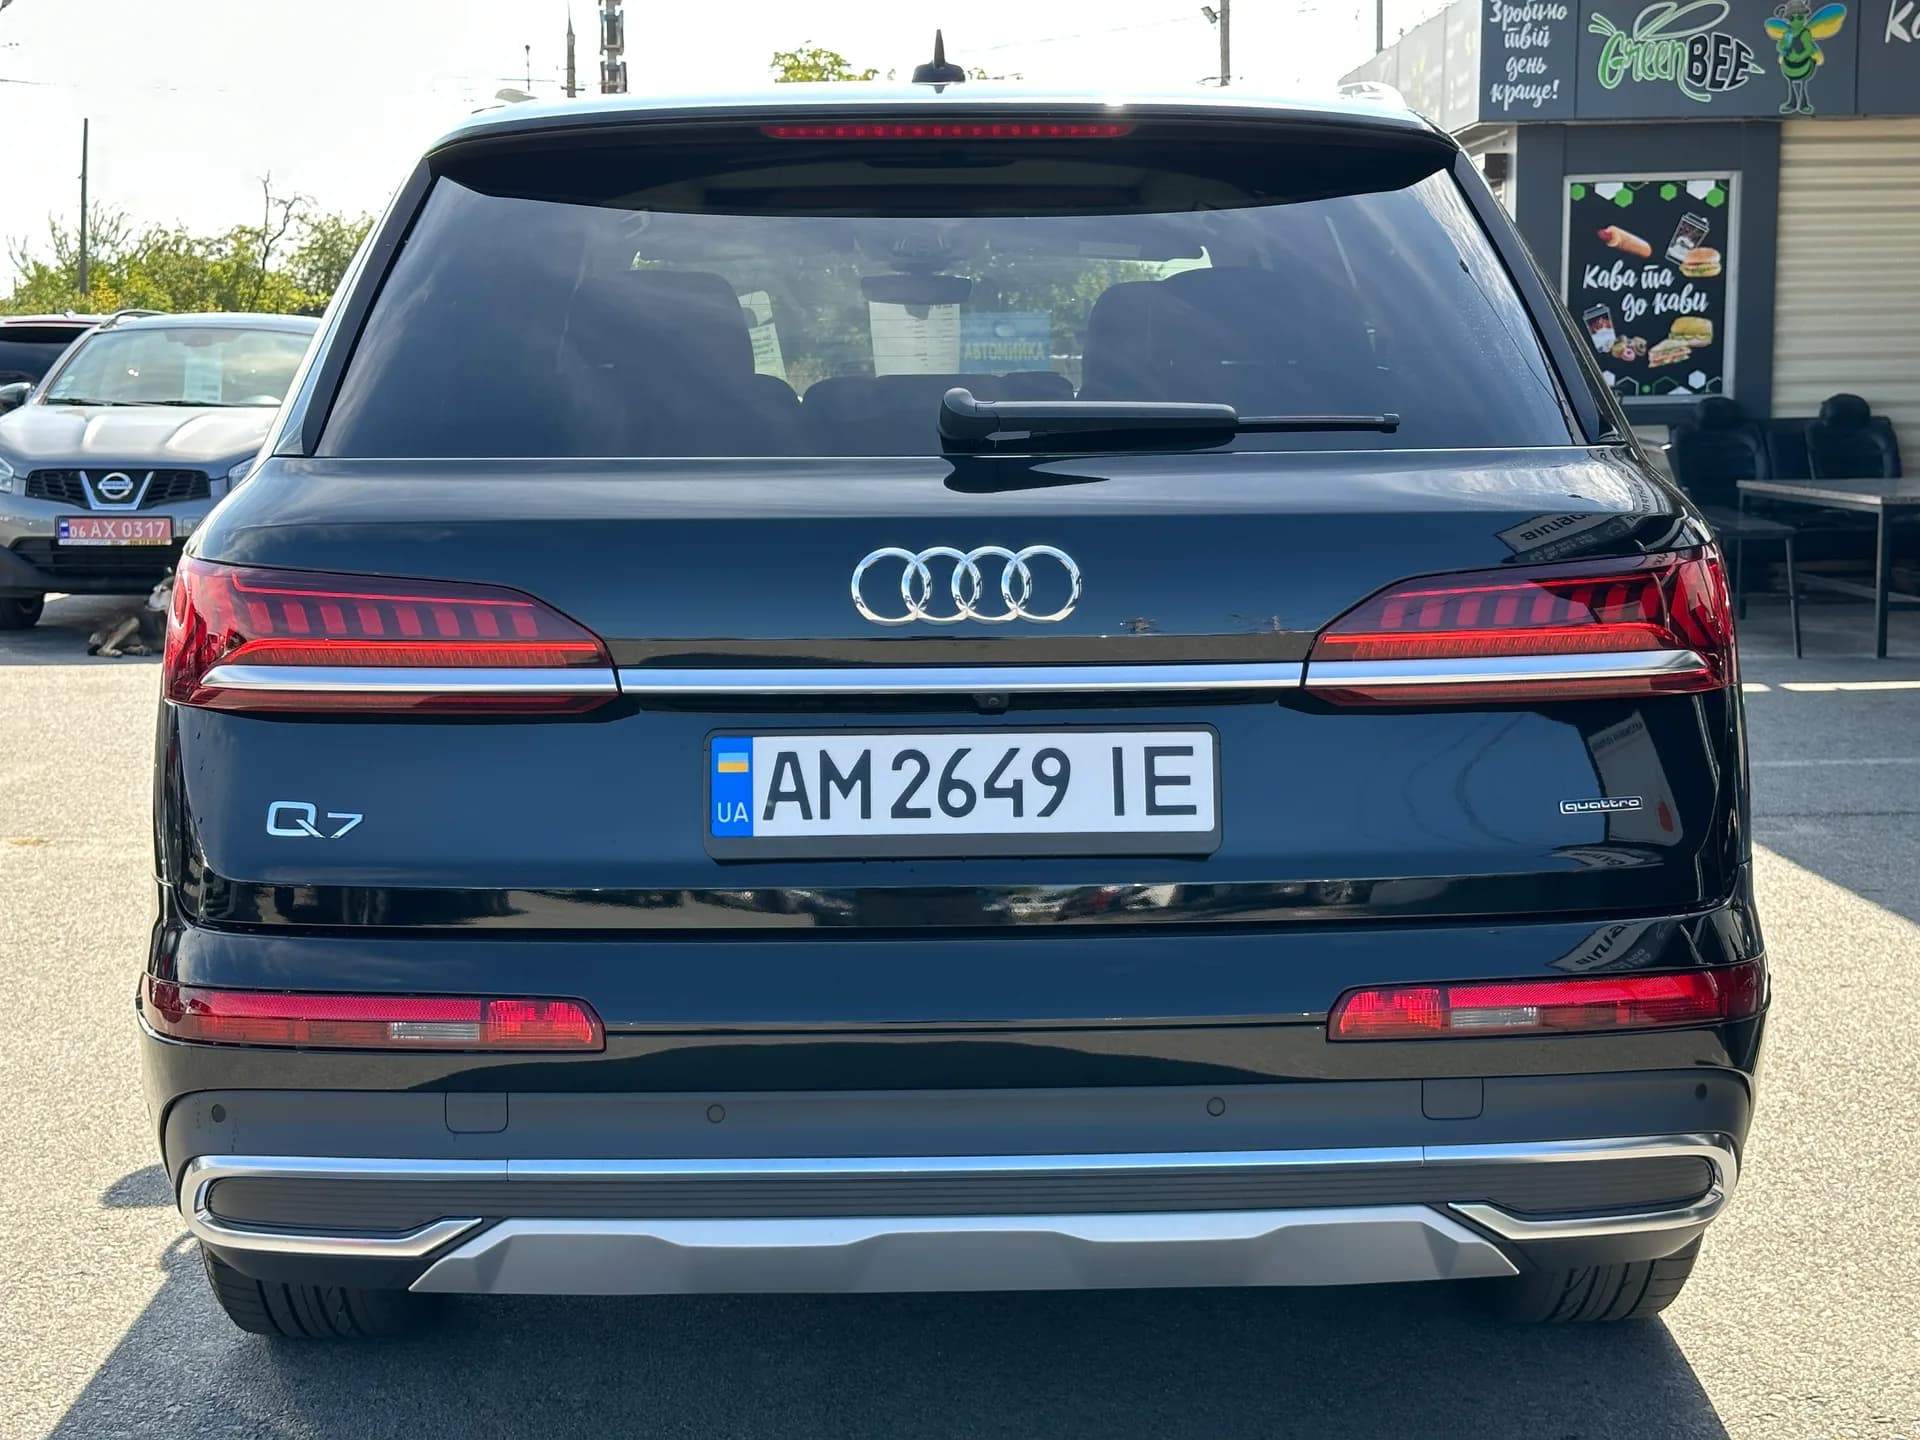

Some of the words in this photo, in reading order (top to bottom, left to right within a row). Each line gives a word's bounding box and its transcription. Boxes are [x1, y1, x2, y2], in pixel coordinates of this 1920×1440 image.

[1489, 0, 1568, 31] Зробимо
[1504, 22, 1551, 49] твій
[1505, 56, 1548, 81] день
[1490, 79, 1560, 111] краще!
[1583, 260, 1638, 291] Кава
[1641, 265, 1675, 289] та
[1621, 293, 1648, 322] до
[1652, 283, 1709, 314] кави
[70, 526, 87, 538] 06
[91, 520, 116, 538] AX
[122, 521, 165, 538] 0317
[717, 802, 749, 823] UA
[763, 749, 871, 820] AM
[890, 747, 1072, 819] 2649
[266, 800, 363, 839] Q7
[1564, 799, 1640, 812] quattro
